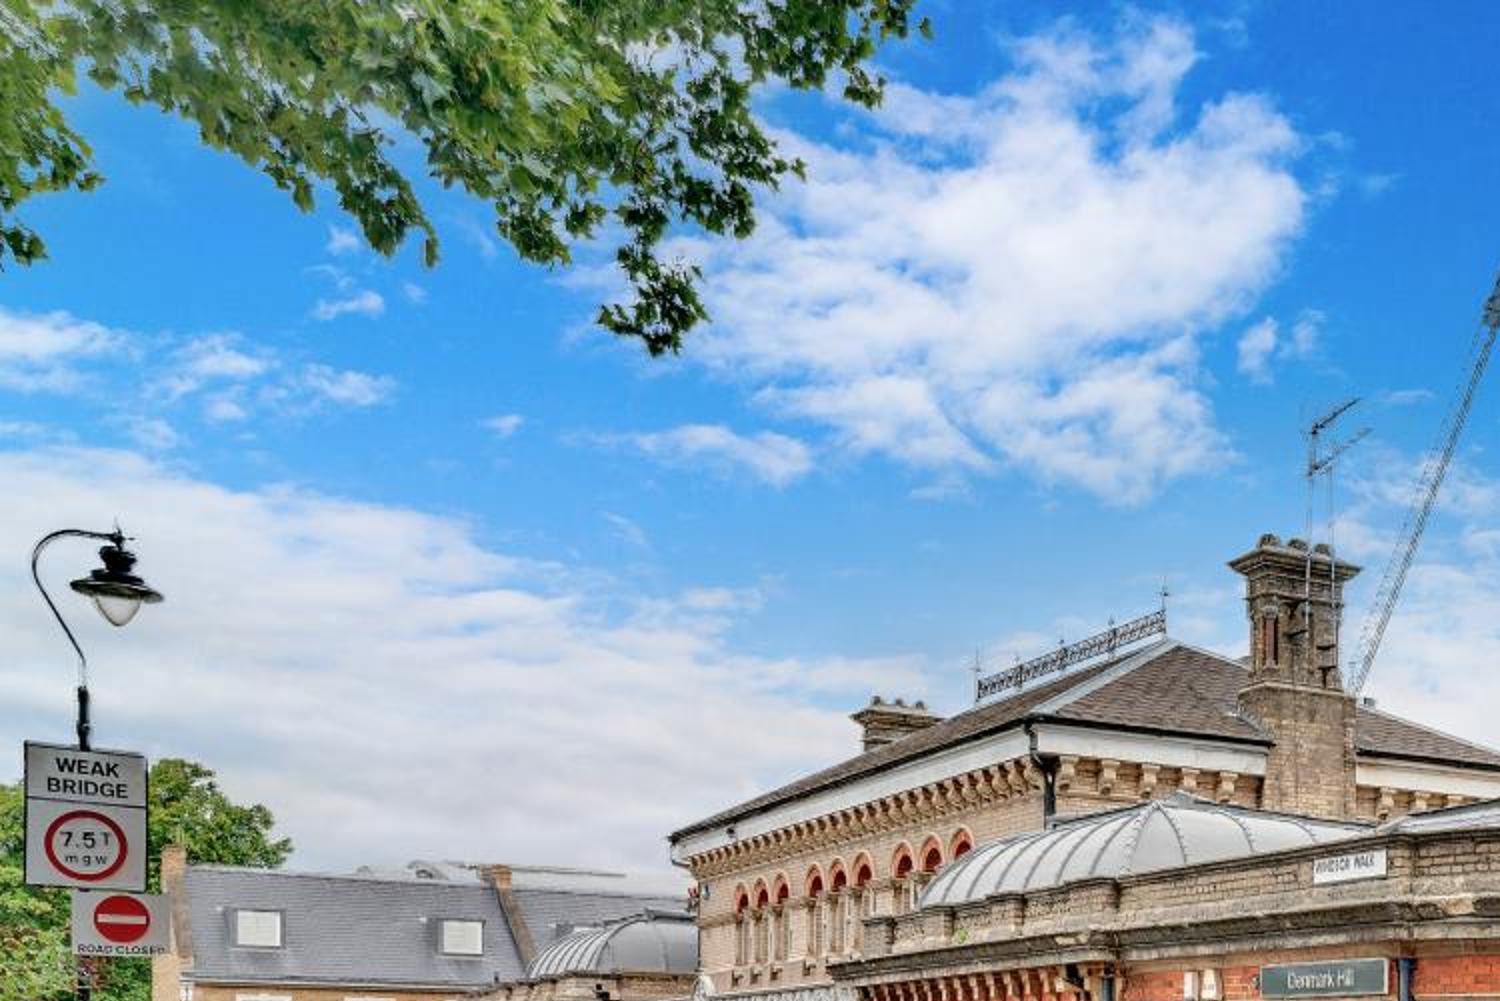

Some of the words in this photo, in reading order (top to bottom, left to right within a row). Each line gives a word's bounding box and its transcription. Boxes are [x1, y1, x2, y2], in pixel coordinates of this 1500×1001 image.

[55, 757, 120, 778] WEAK
[47, 777, 129, 799] BRIDGE
[77, 943, 113, 954] ROAD
[1287, 968, 1335, 990] Denmark
[1337, 967, 1355, 988] Hill
